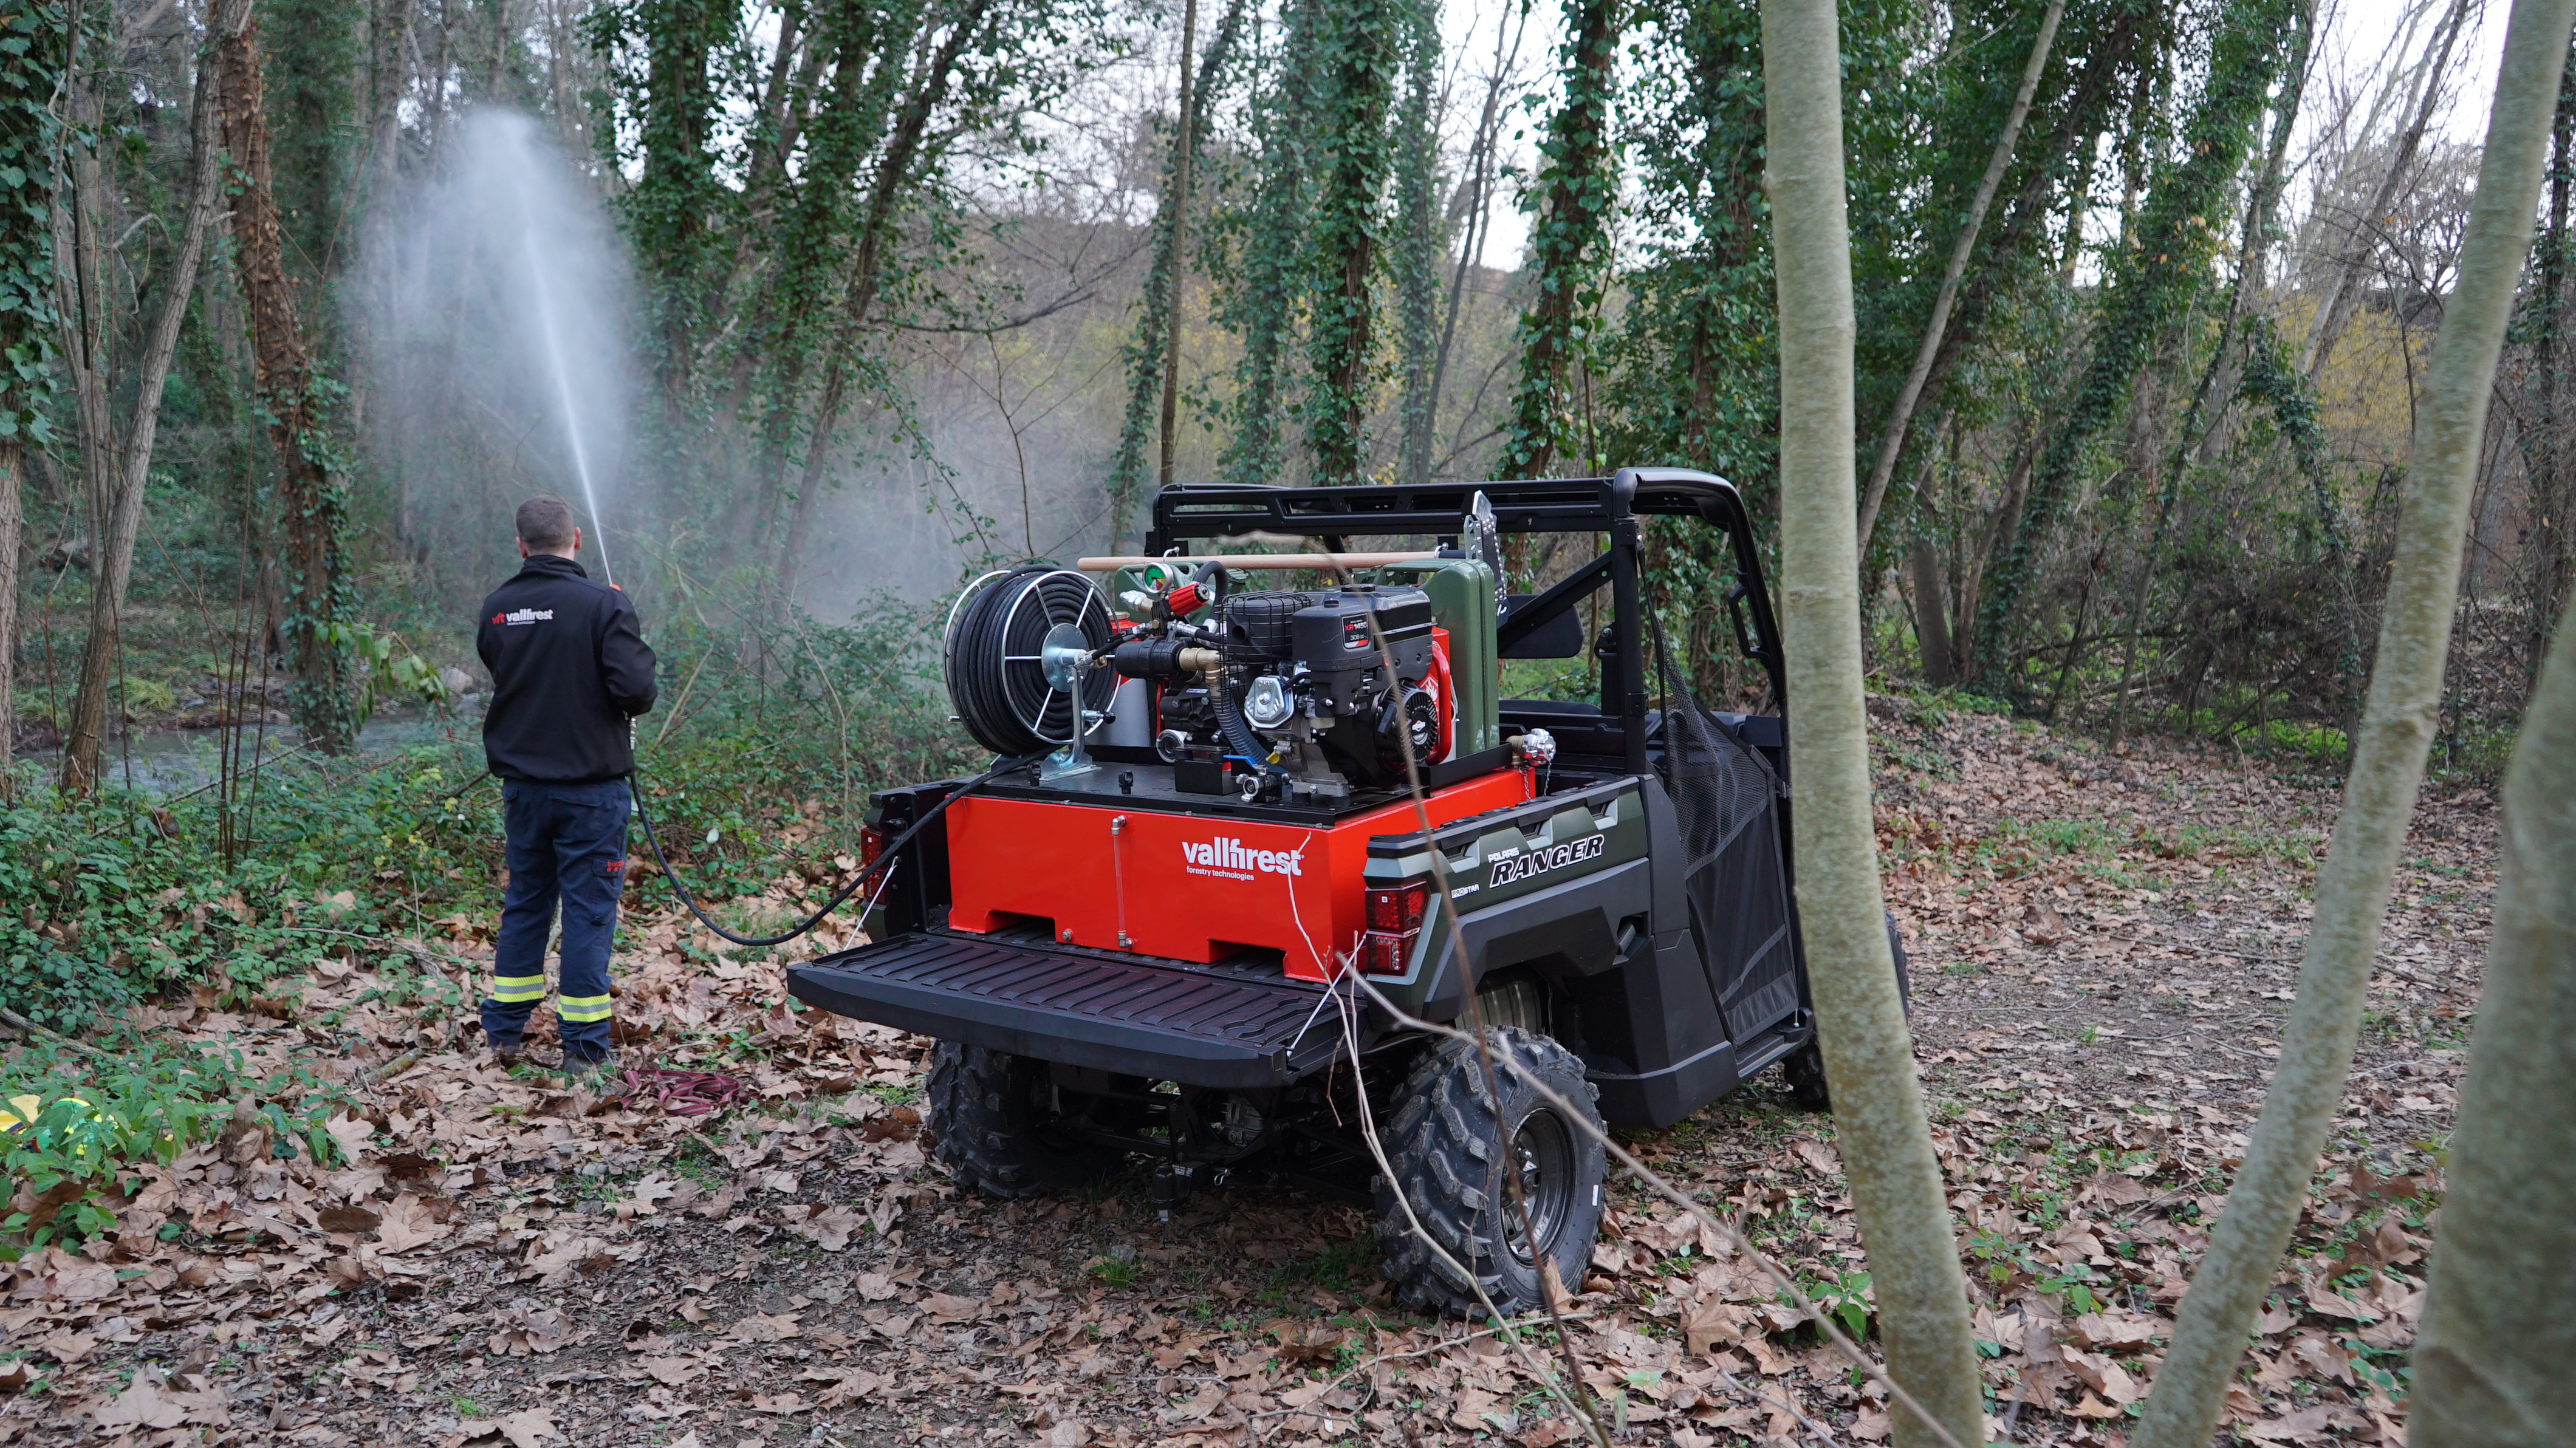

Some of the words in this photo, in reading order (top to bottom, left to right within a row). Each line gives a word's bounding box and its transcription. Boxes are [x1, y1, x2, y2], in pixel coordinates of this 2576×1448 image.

[506, 608, 553, 621] vallfirest
[1182, 836, 1303, 876] vallfirest
[1487, 847, 1519, 863] POLARIS
[1489, 834, 1605, 888] RANGER
[1187, 865, 1211, 876] forestry
[1212, 869, 1255, 881] technologies
[1451, 884, 1479, 899] PROSTAR
